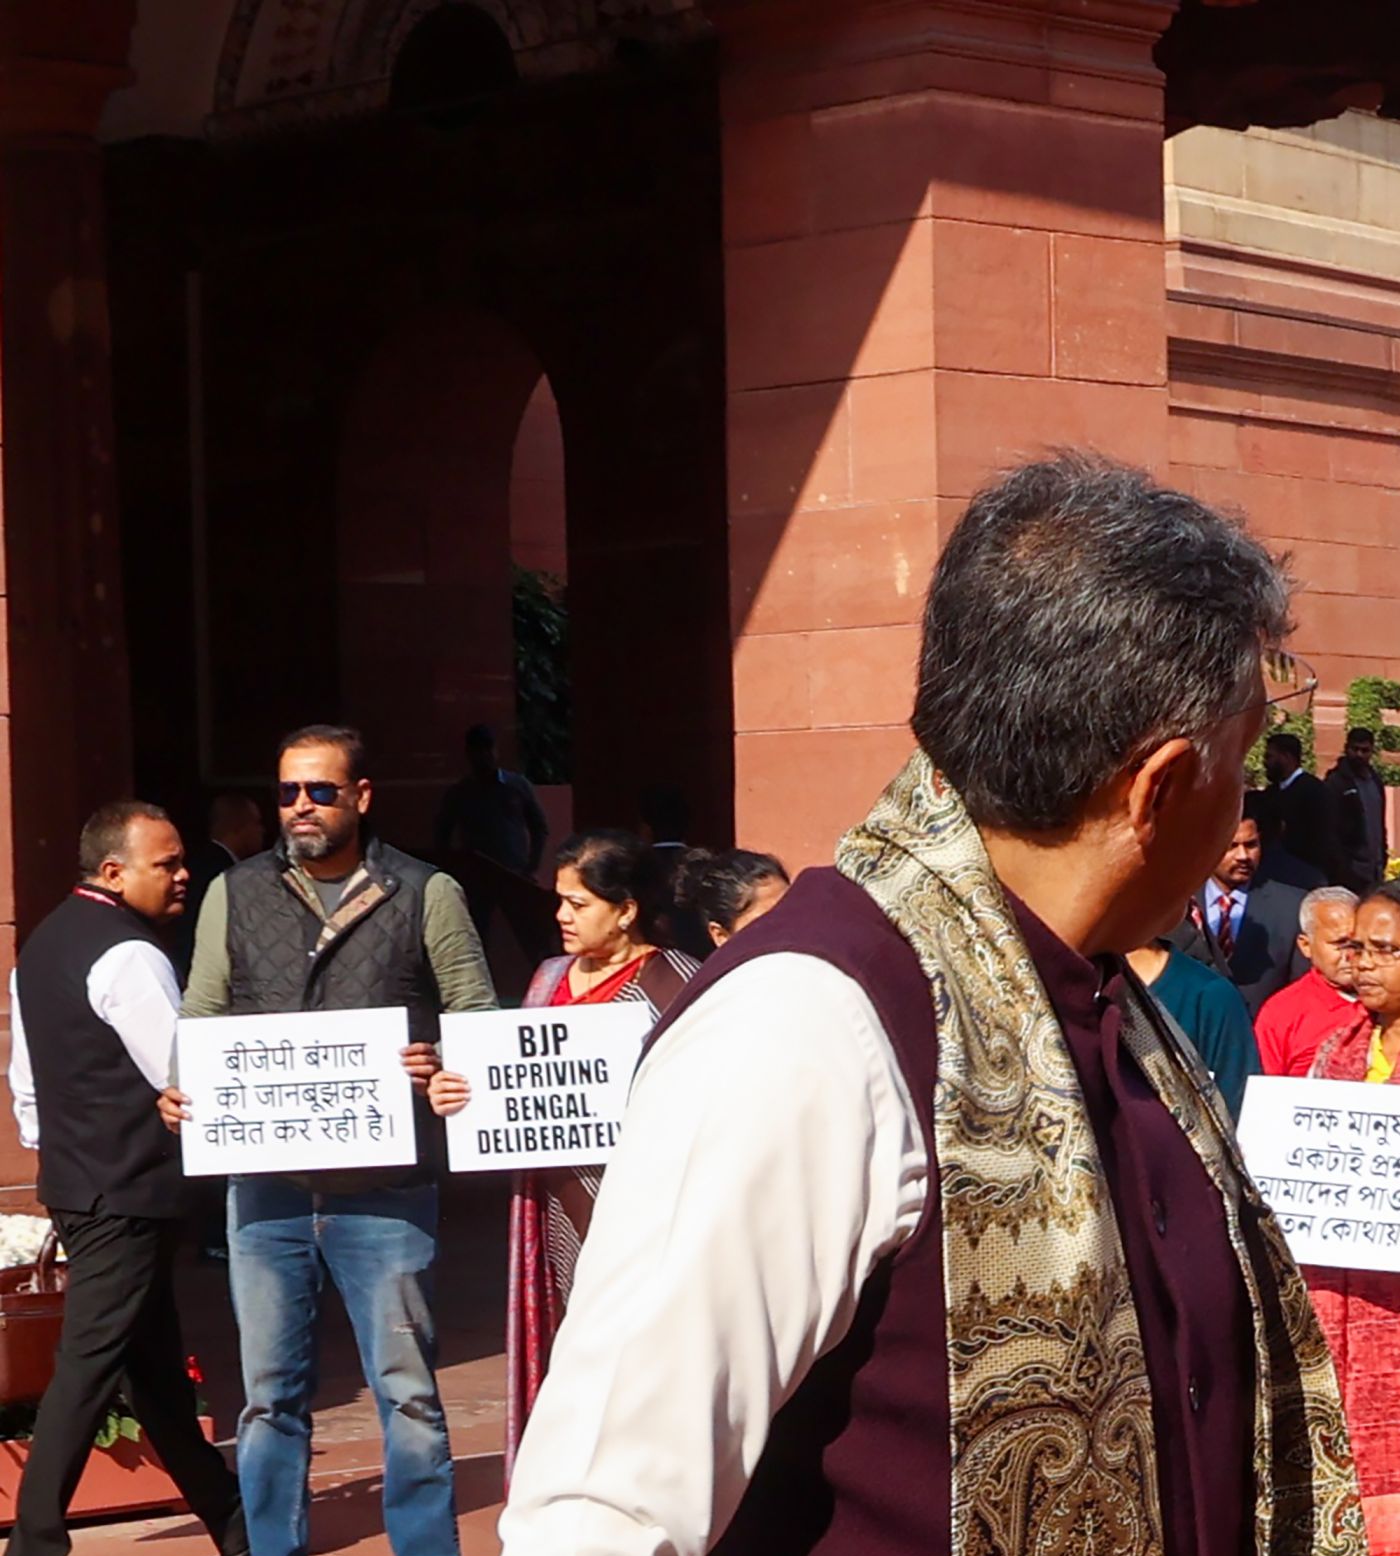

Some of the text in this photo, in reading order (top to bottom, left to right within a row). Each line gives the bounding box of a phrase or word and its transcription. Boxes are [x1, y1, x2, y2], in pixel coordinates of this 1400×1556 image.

[223, 1039, 367, 1072] बीजेपी बंगाल
[517, 1022, 569, 1059] BJP
[487, 1057, 610, 1091] DEPRIVING
[214, 1076, 380, 1113] को जानबूझकर
[203, 1114, 265, 1145] वंचित
[271, 1118, 312, 1142] कर
[318, 1107, 359, 1143] रही
[1293, 1106, 1342, 1132] লক্ষ
[477, 1121, 622, 1155] DELIBERATEL
[1287, 1142, 1367, 1176] একটাই
[1274, 1211, 1318, 1239] তন
